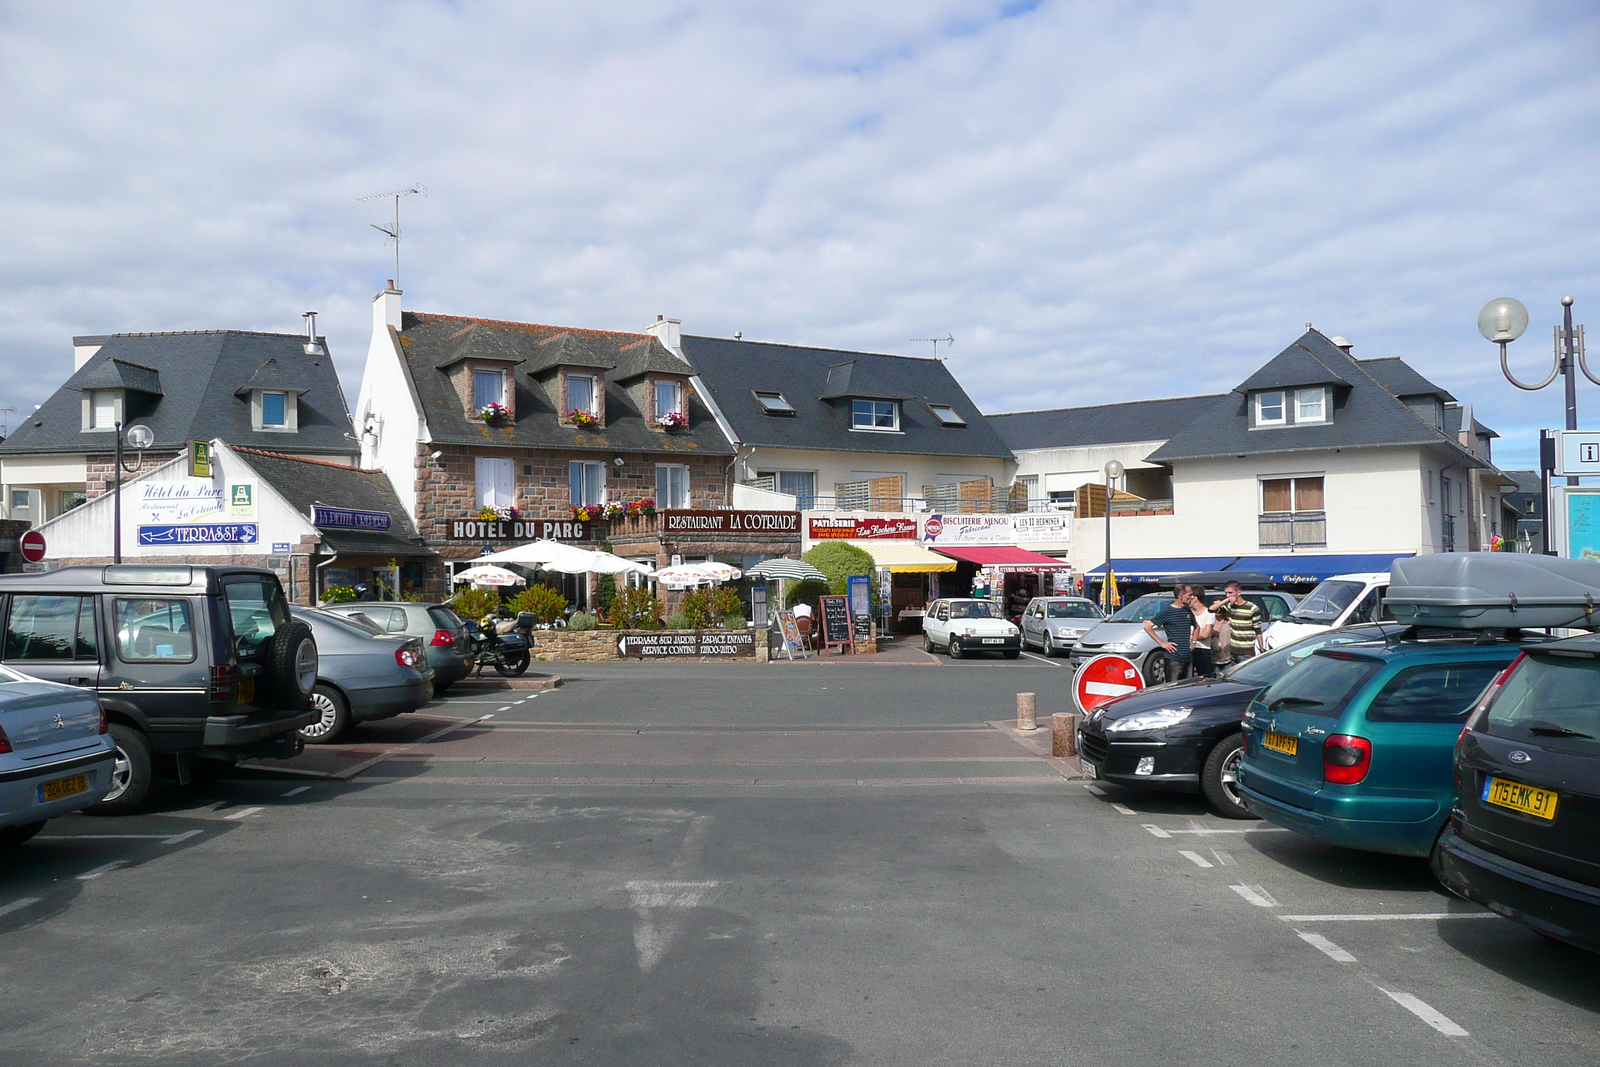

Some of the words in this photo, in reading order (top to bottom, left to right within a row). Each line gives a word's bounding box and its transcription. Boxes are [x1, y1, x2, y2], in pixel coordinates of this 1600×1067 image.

[143, 484, 172, 498] Hôtel
[176, 484, 190, 498] du
[194, 483, 223, 497] Parc
[320, 510, 328, 524] LA
[329, 511, 352, 526] PETITE
[668, 516, 724, 528] RESTAURANT
[730, 514, 741, 529] LA
[744, 514, 796, 530] COTRIADE
[943, 517, 982, 525] BISCUITERIE
[984, 517, 1008, 525] MENOU
[1036, 518, 1060, 526] HERMINES
[175, 526, 238, 542] TERRASSE
[454, 522, 506, 538] HOTEL
[514, 522, 535, 538] DU
[544, 522, 583, 538] PARC
[856, 526, 870, 536] Les
[870, 524, 896, 534] Rochers
[960, 524, 991, 537] Fabricant
[626, 636, 658, 645] TERRASSE
[659, 636, 672, 644] SUR
[674, 636, 696, 644] JARDIN
[642, 646, 667, 654] SERVICE
[668, 646, 696, 654] CONTINU
[1494, 781, 1510, 801] 175
[1510, 786, 1534, 808] EMK
[1534, 793, 1550, 812] 91
